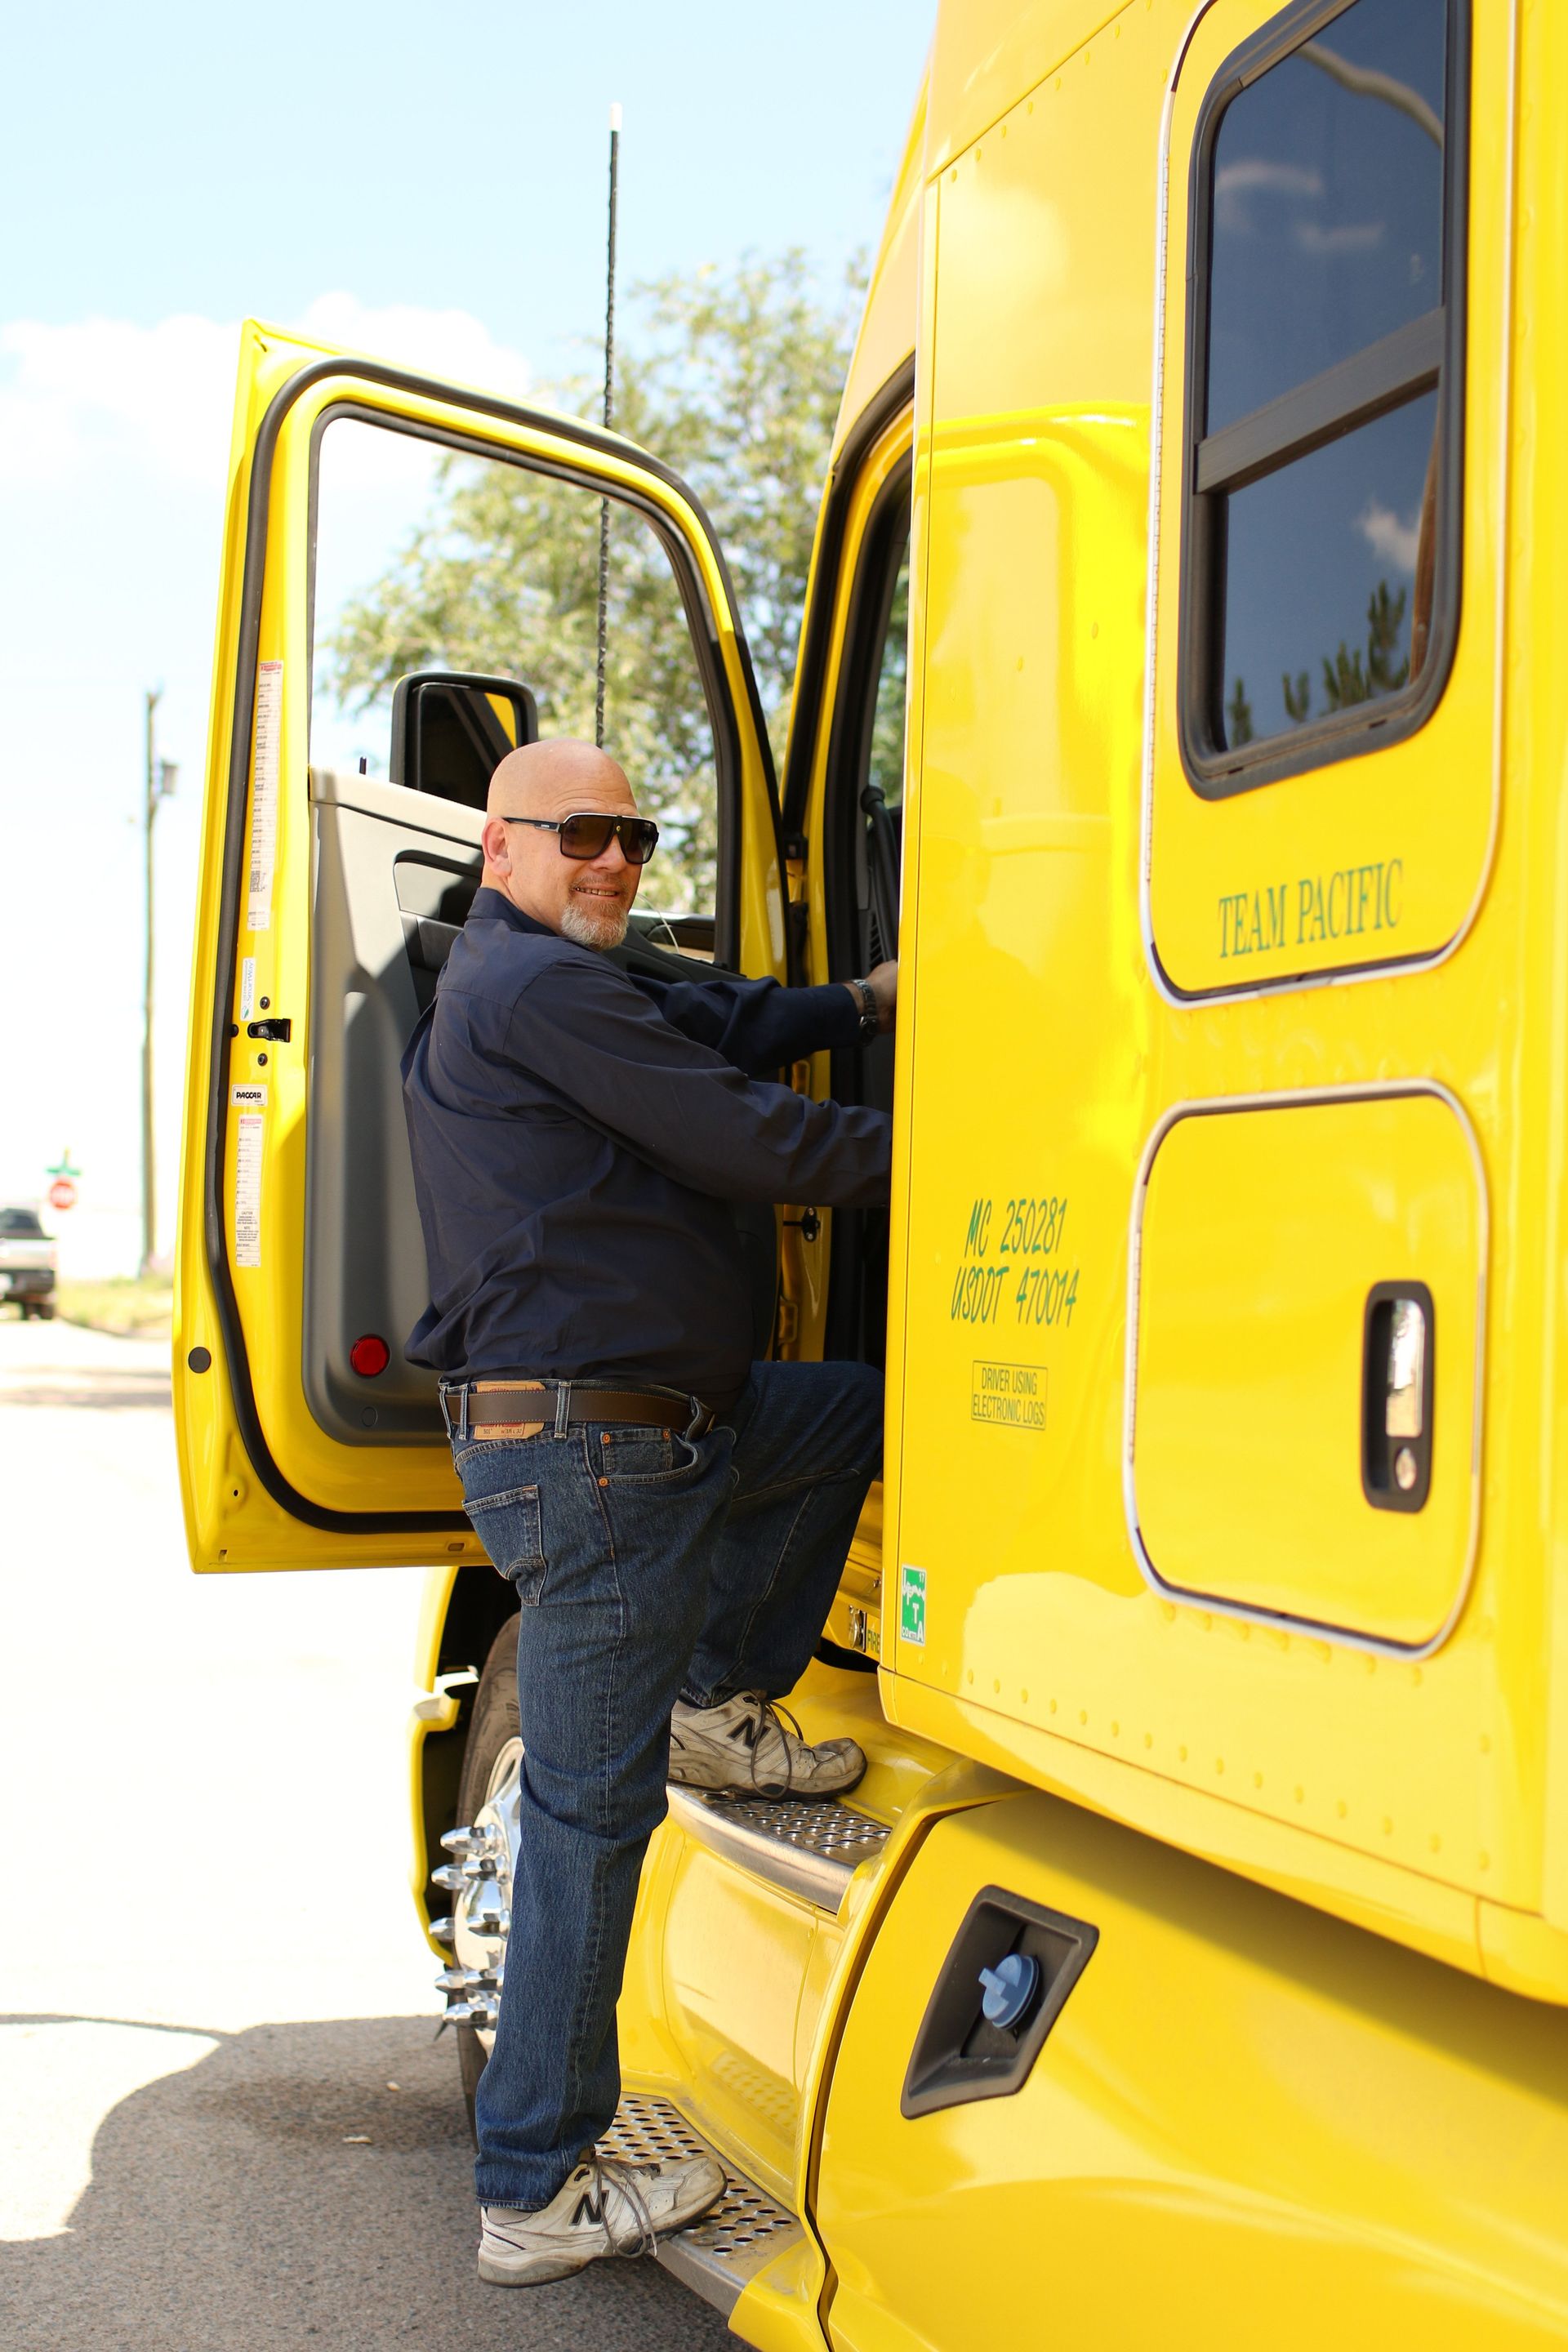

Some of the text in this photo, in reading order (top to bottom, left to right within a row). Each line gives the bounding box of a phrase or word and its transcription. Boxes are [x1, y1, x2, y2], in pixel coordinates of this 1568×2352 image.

[1218, 858, 1403, 957] TEAM PACIFIC
[236, 1091, 262, 1099] PACCAR
[964, 1196, 1067, 1258] MC 250281
[951, 1266, 1080, 1328] USDOT 470014
[982, 1367, 1037, 1396] DRIVER USING
[973, 1393, 1045, 1425] ELECTRONIC LOGS
